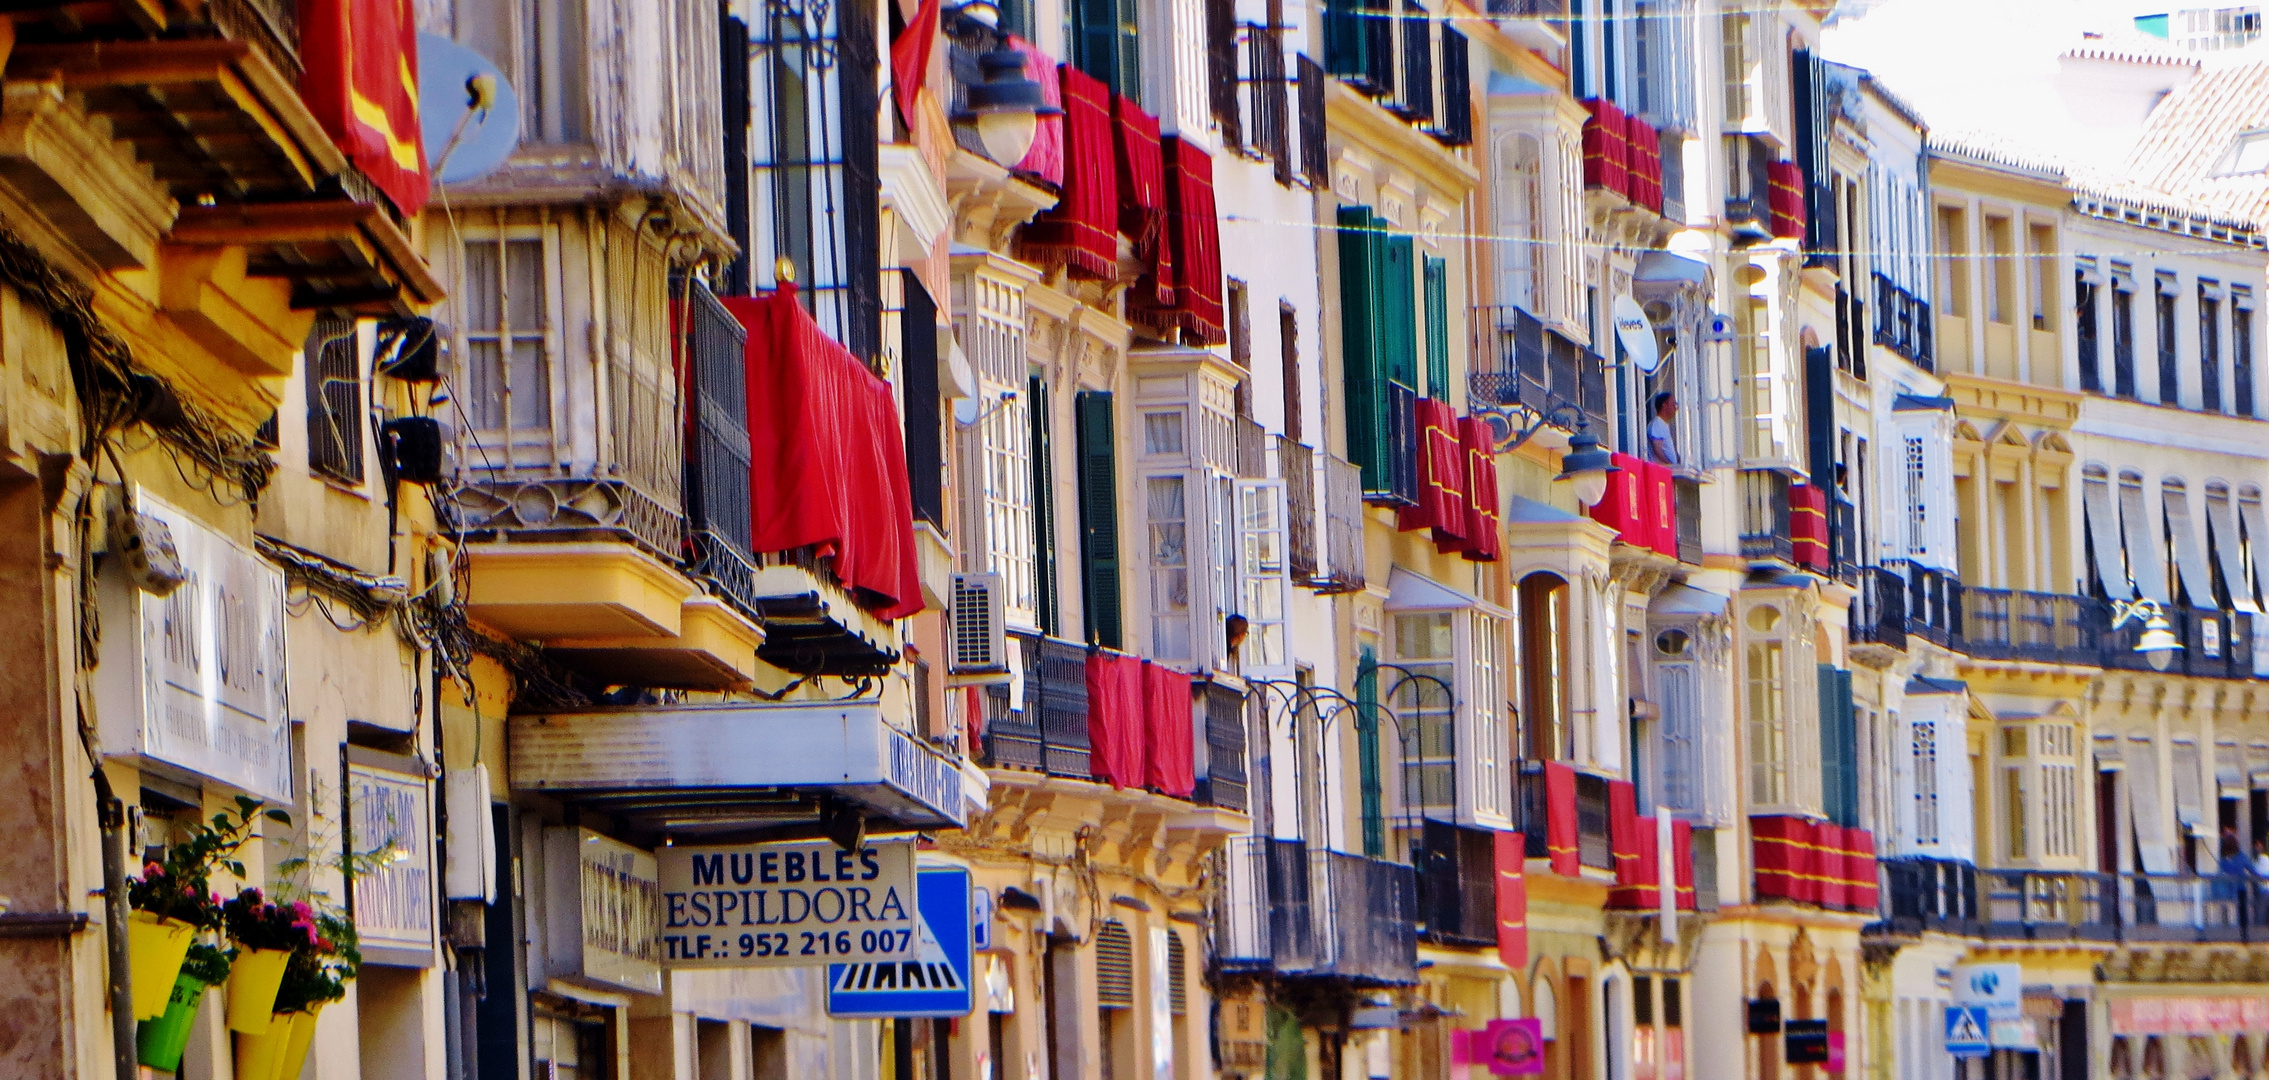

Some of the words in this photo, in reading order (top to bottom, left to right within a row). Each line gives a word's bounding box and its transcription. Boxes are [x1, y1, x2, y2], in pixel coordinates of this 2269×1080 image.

[692, 848, 880, 886] MUEBLES
[664, 886, 909, 927] ESPILDORA
[664, 935, 728, 959] TLF.:
[738, 933, 789, 957] 952
[800, 931, 851, 955] 216
[861, 929, 911, 954] 007
